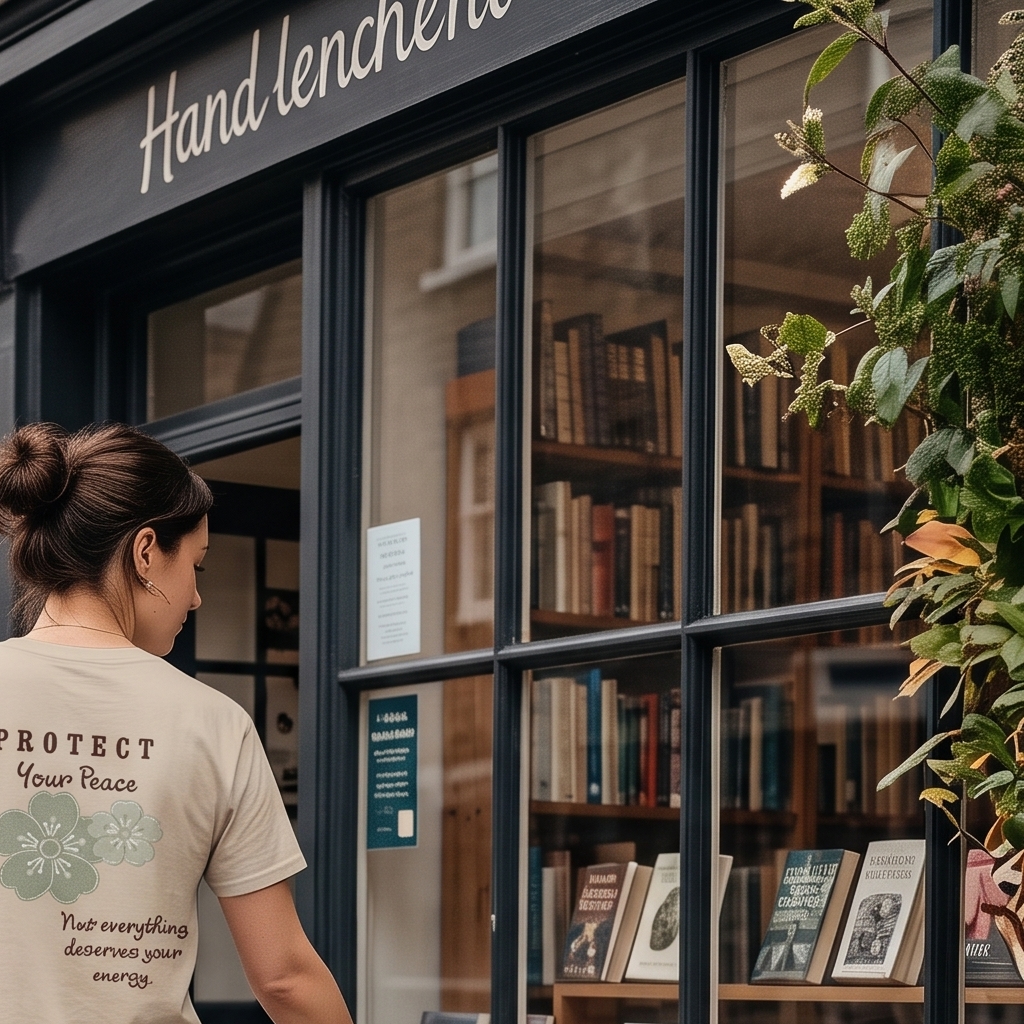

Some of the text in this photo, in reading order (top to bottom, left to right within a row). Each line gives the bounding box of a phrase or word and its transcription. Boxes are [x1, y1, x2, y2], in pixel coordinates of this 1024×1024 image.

[139, 29, 269, 194] Hand
[16, 761, 138, 793] Your Peace
[100, 915, 189, 941] everything
[63, 938, 183, 964] deserves your
